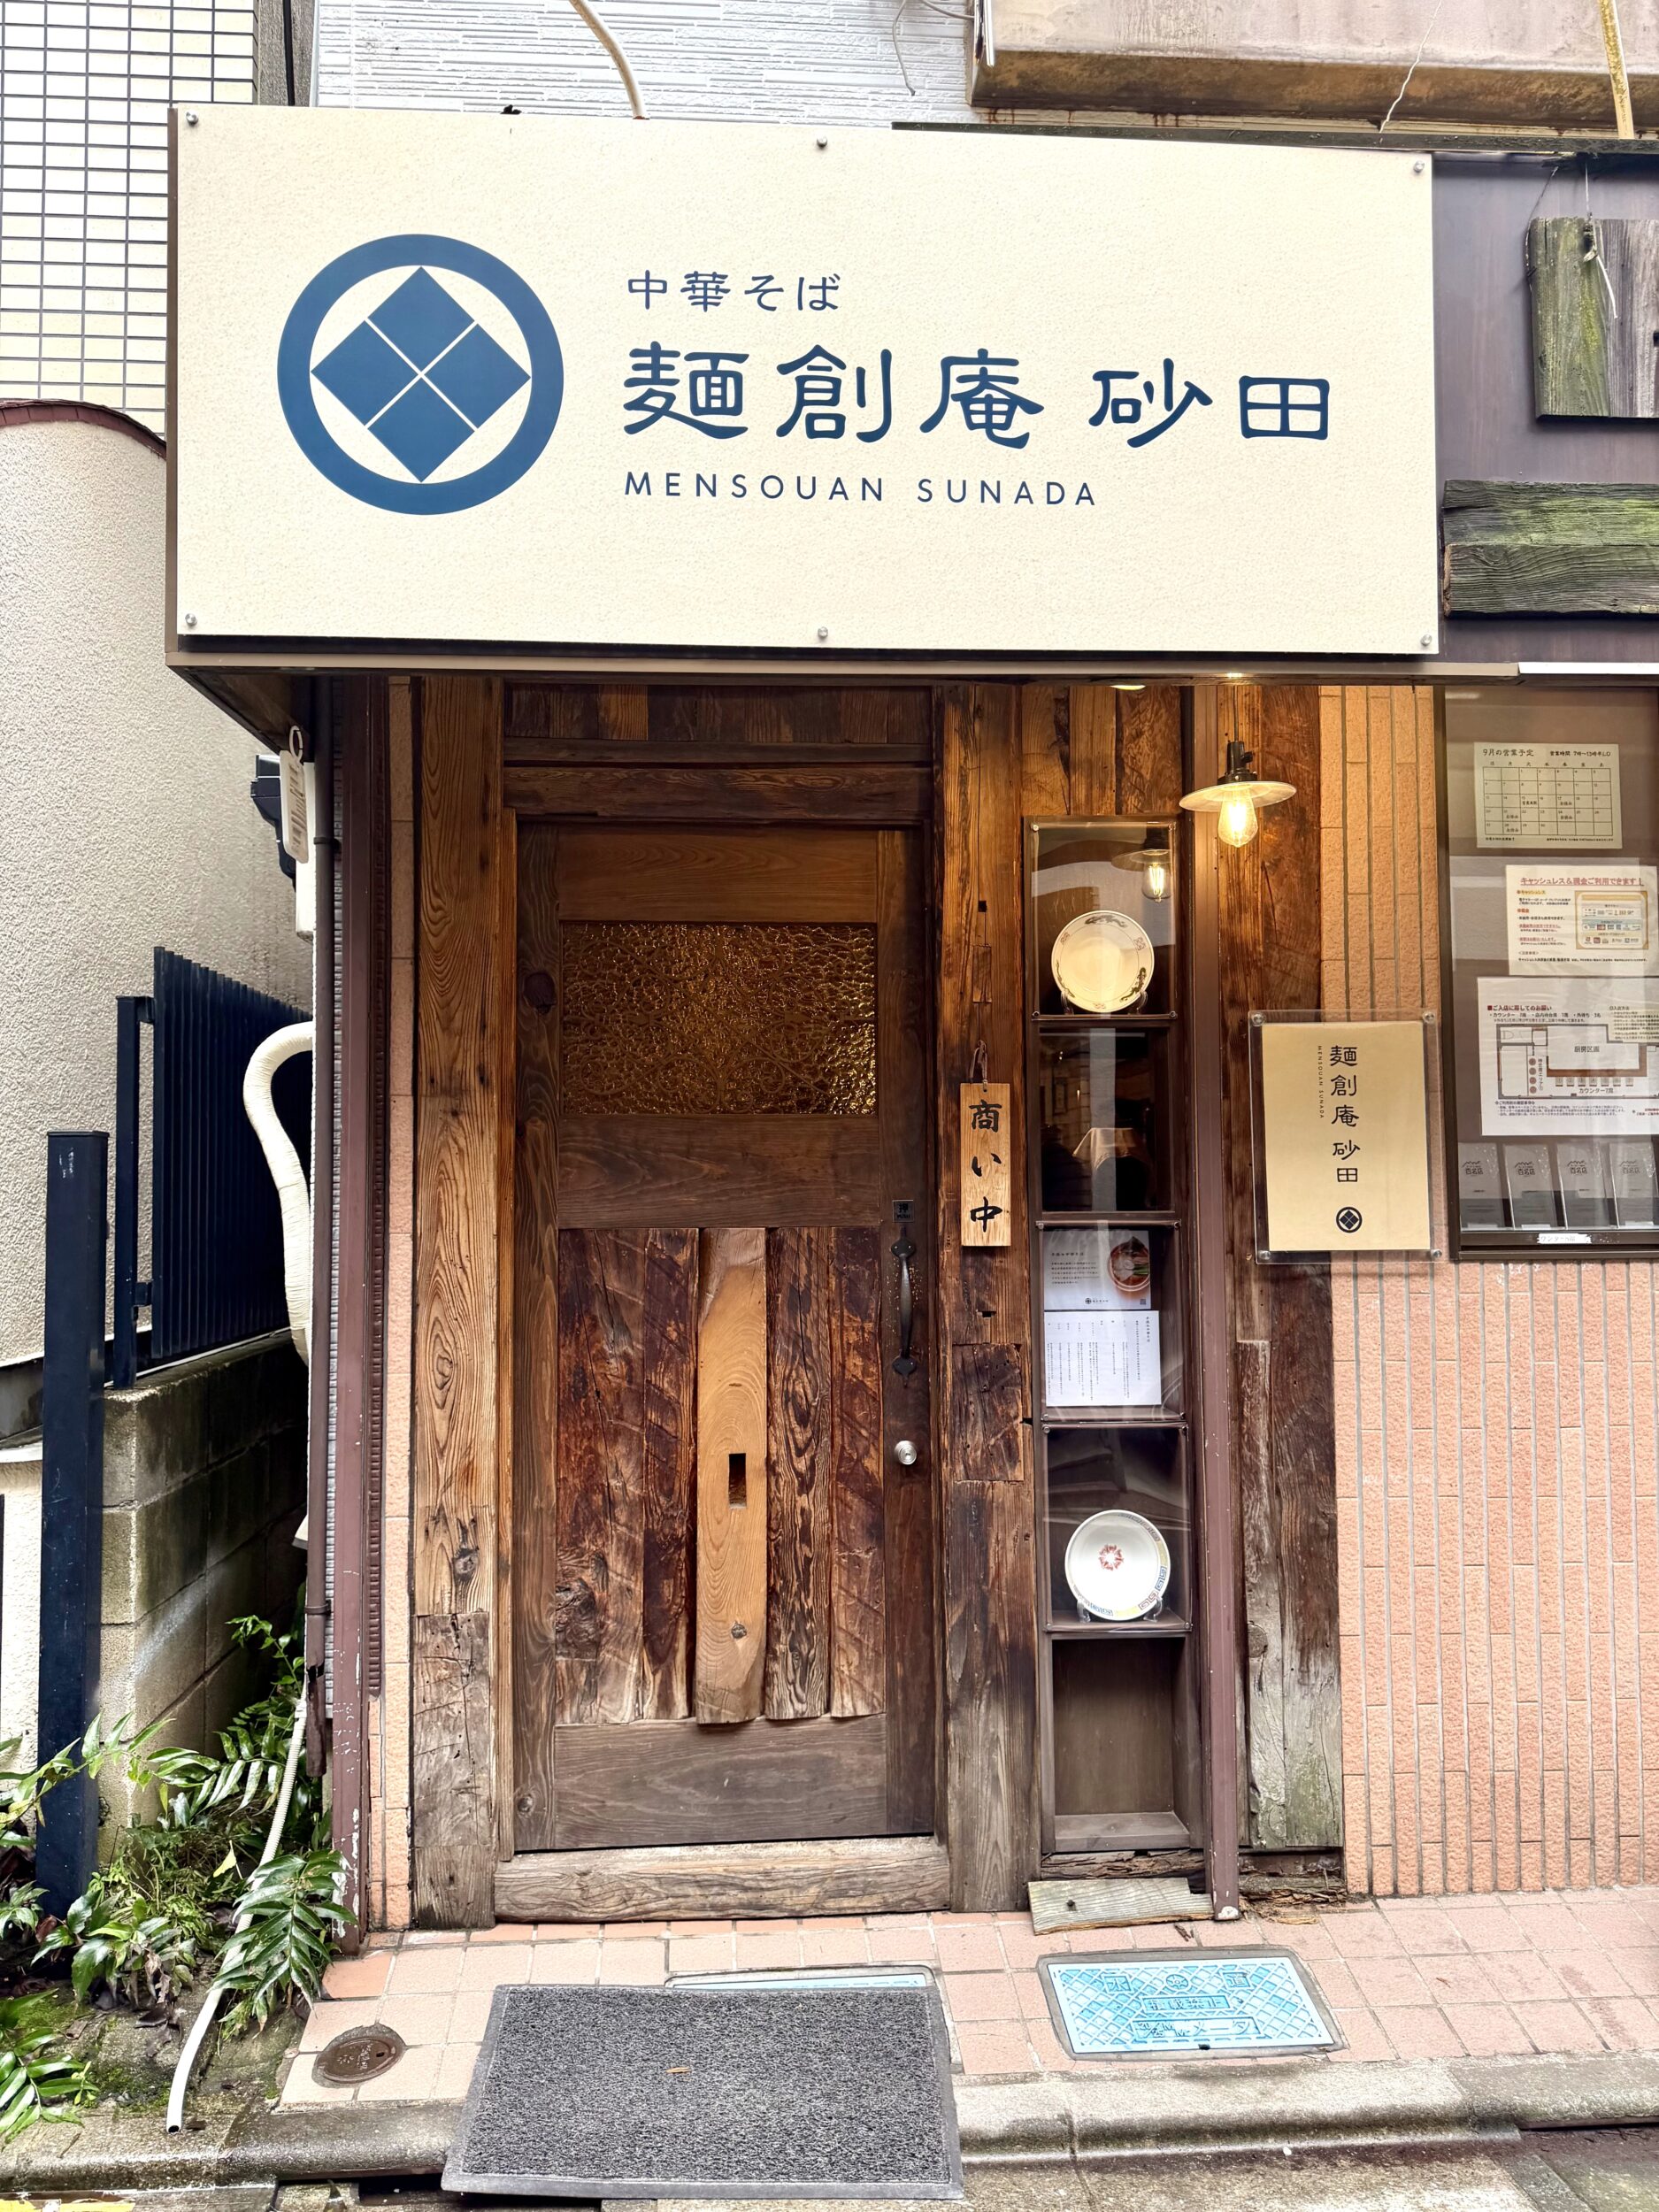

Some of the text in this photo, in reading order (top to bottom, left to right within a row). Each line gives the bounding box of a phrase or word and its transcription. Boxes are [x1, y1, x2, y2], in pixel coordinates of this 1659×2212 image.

[628, 269, 841, 311] 中華そば
[623, 342, 1331, 449] 麺創庵 砂田
[625, 471, 1095, 507] MENSOUAN SUNADA
[969, 1099, 1002, 1233] 商い中
